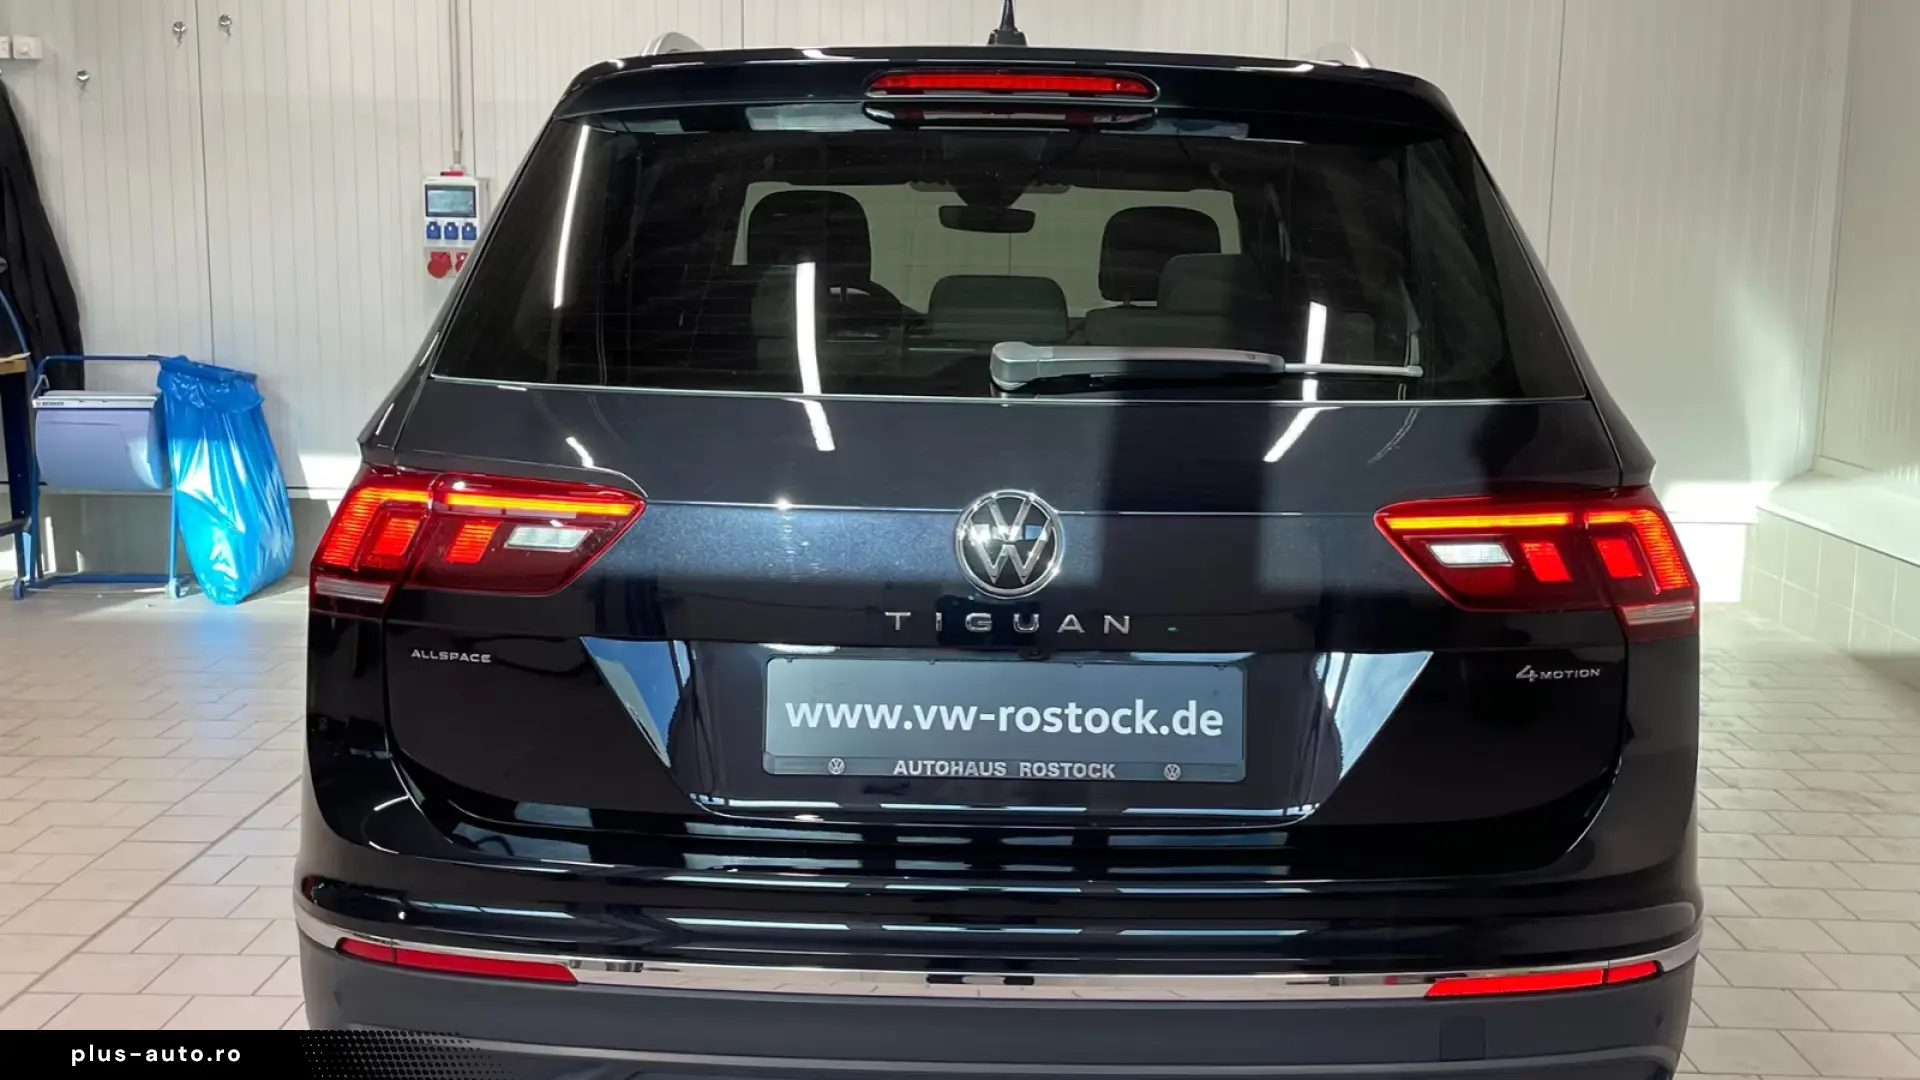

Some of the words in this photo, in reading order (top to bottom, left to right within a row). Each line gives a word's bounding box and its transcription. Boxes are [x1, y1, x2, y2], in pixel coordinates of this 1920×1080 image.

[884, 611, 1131, 635] TIGUAN
[411, 648, 492, 663] ALLSPACE
[1515, 664, 1601, 683] 4MOTION
[785, 698, 1224, 737] www.vw-rostock.de
[893, 759, 1007, 777] AUTOHAUS
[1019, 761, 1117, 779] ROSTOCK
